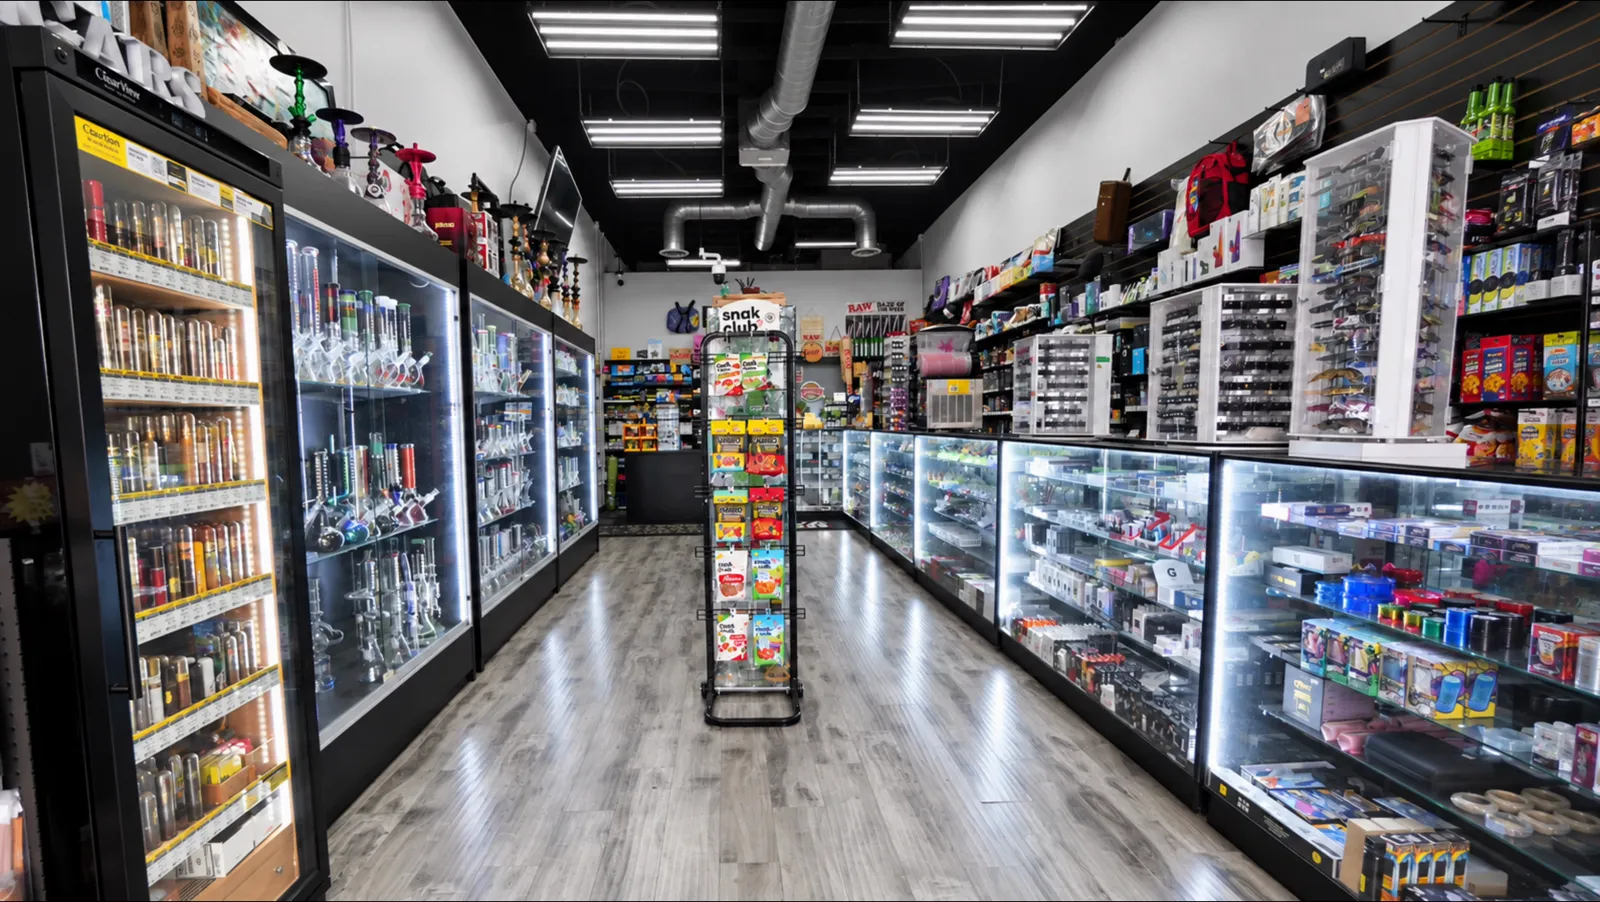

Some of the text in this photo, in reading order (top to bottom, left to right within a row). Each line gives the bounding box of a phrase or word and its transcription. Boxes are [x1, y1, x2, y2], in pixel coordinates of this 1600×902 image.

[722, 306, 761, 321] snak
[847, 302, 873, 313] RAW
[723, 320, 759, 333] club
[1167, 567, 1177, 578] G
